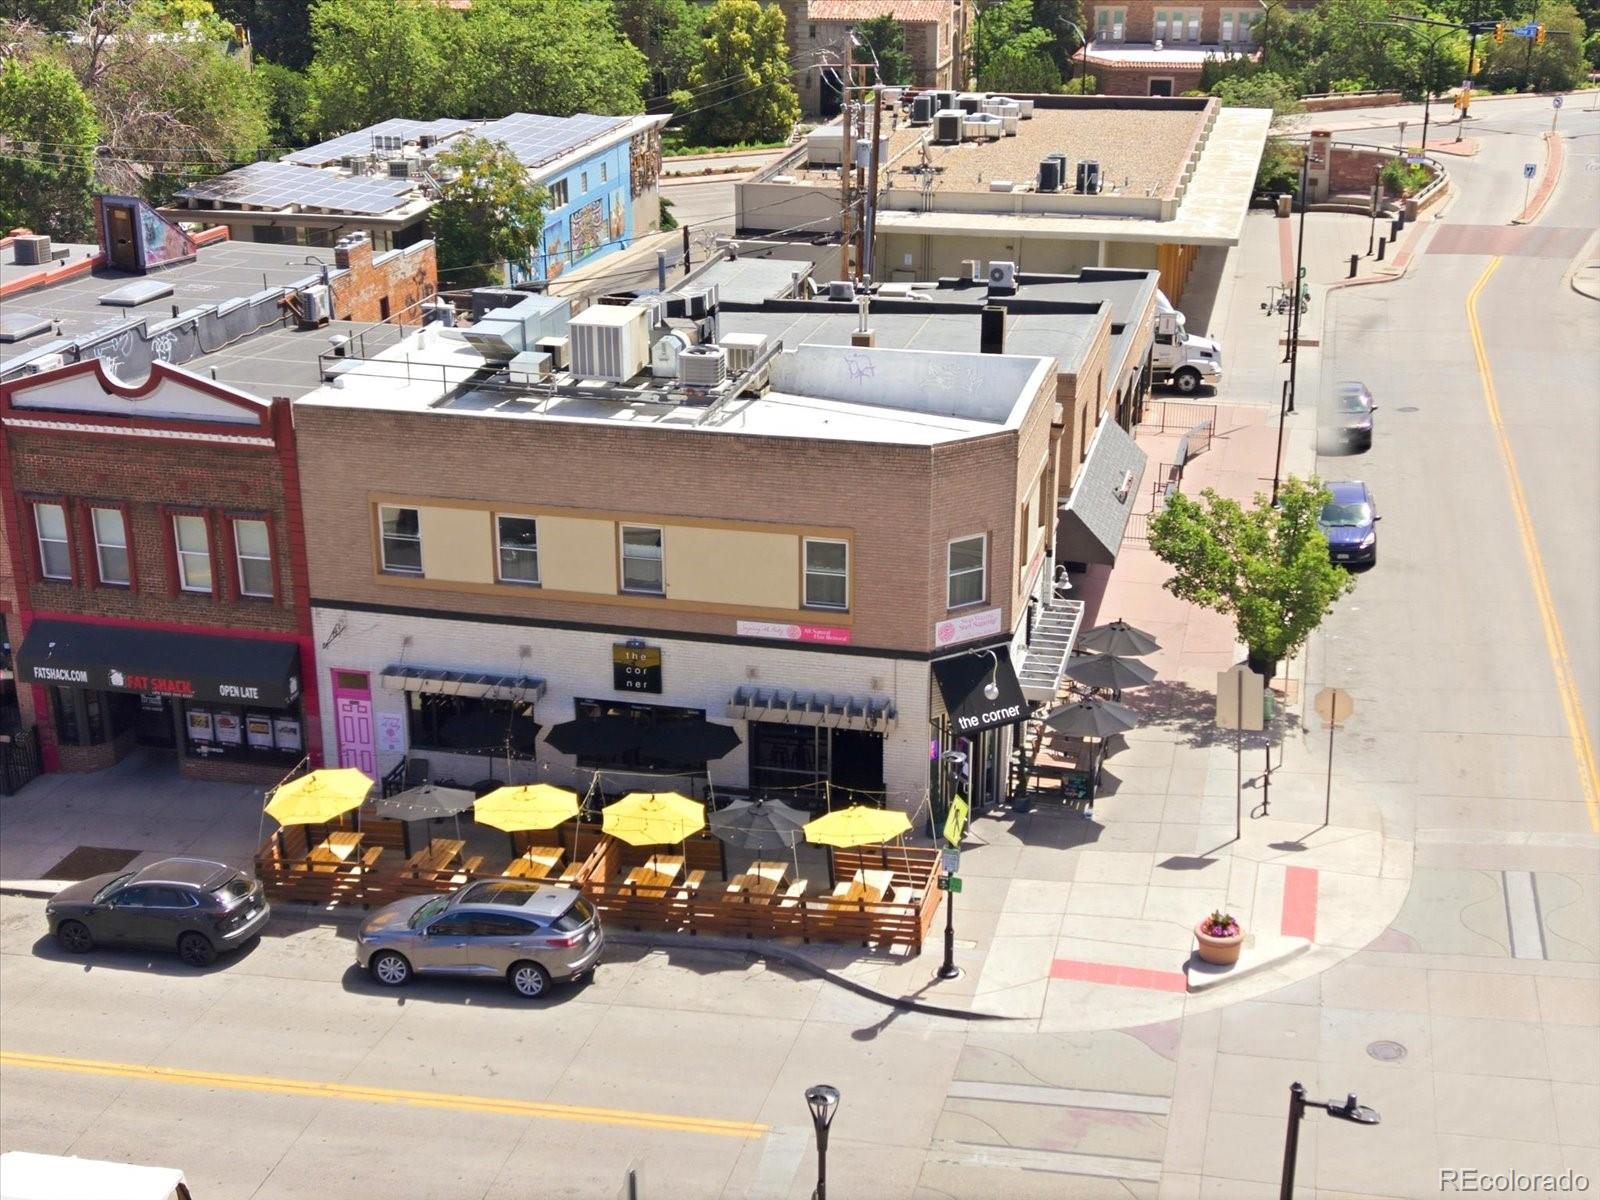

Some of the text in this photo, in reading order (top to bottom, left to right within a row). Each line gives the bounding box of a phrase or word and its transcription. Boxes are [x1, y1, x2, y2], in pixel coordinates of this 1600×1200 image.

[625, 652, 647, 661] the
[33, 666, 88, 683] FATSHACK.COM
[625, 666, 648, 675] cor
[127, 675, 193, 694] FAT SHACK
[219, 684, 259, 700] OPEN LATE
[626, 680, 648, 689] ner
[958, 704, 1020, 730] the corner
